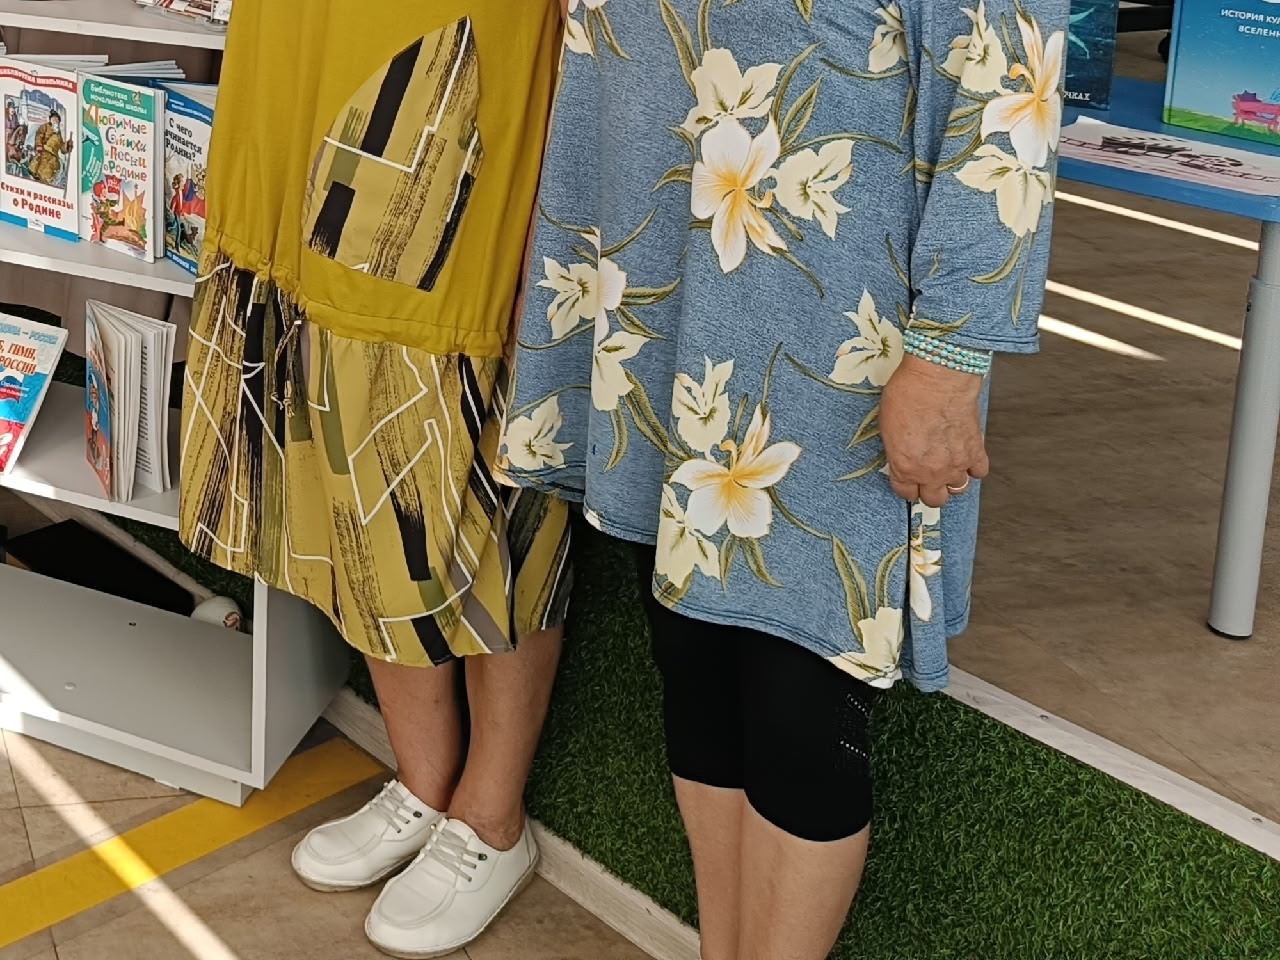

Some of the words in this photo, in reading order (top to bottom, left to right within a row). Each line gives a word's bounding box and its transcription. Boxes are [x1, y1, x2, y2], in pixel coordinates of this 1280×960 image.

[1220, 7, 1264, 23] ИСТОРИЯ
[35, 75, 75, 90] ШКОЛЬНИКА
[89, 83, 129, 103] Библиотека
[89, 92, 124, 109] начальной
[124, 100, 148, 115] школы
[85, 102, 148, 136] Любимые
[168, 117, 175, 129] С
[175, 122, 193, 139] чего
[108, 159, 148, 183] Родине
[0, 180, 24, 197] Стихи
[33, 190, 75, 211] рассказы
[20, 199, 62, 220] Родине
[7, 342, 37, 362] ГИМН,
